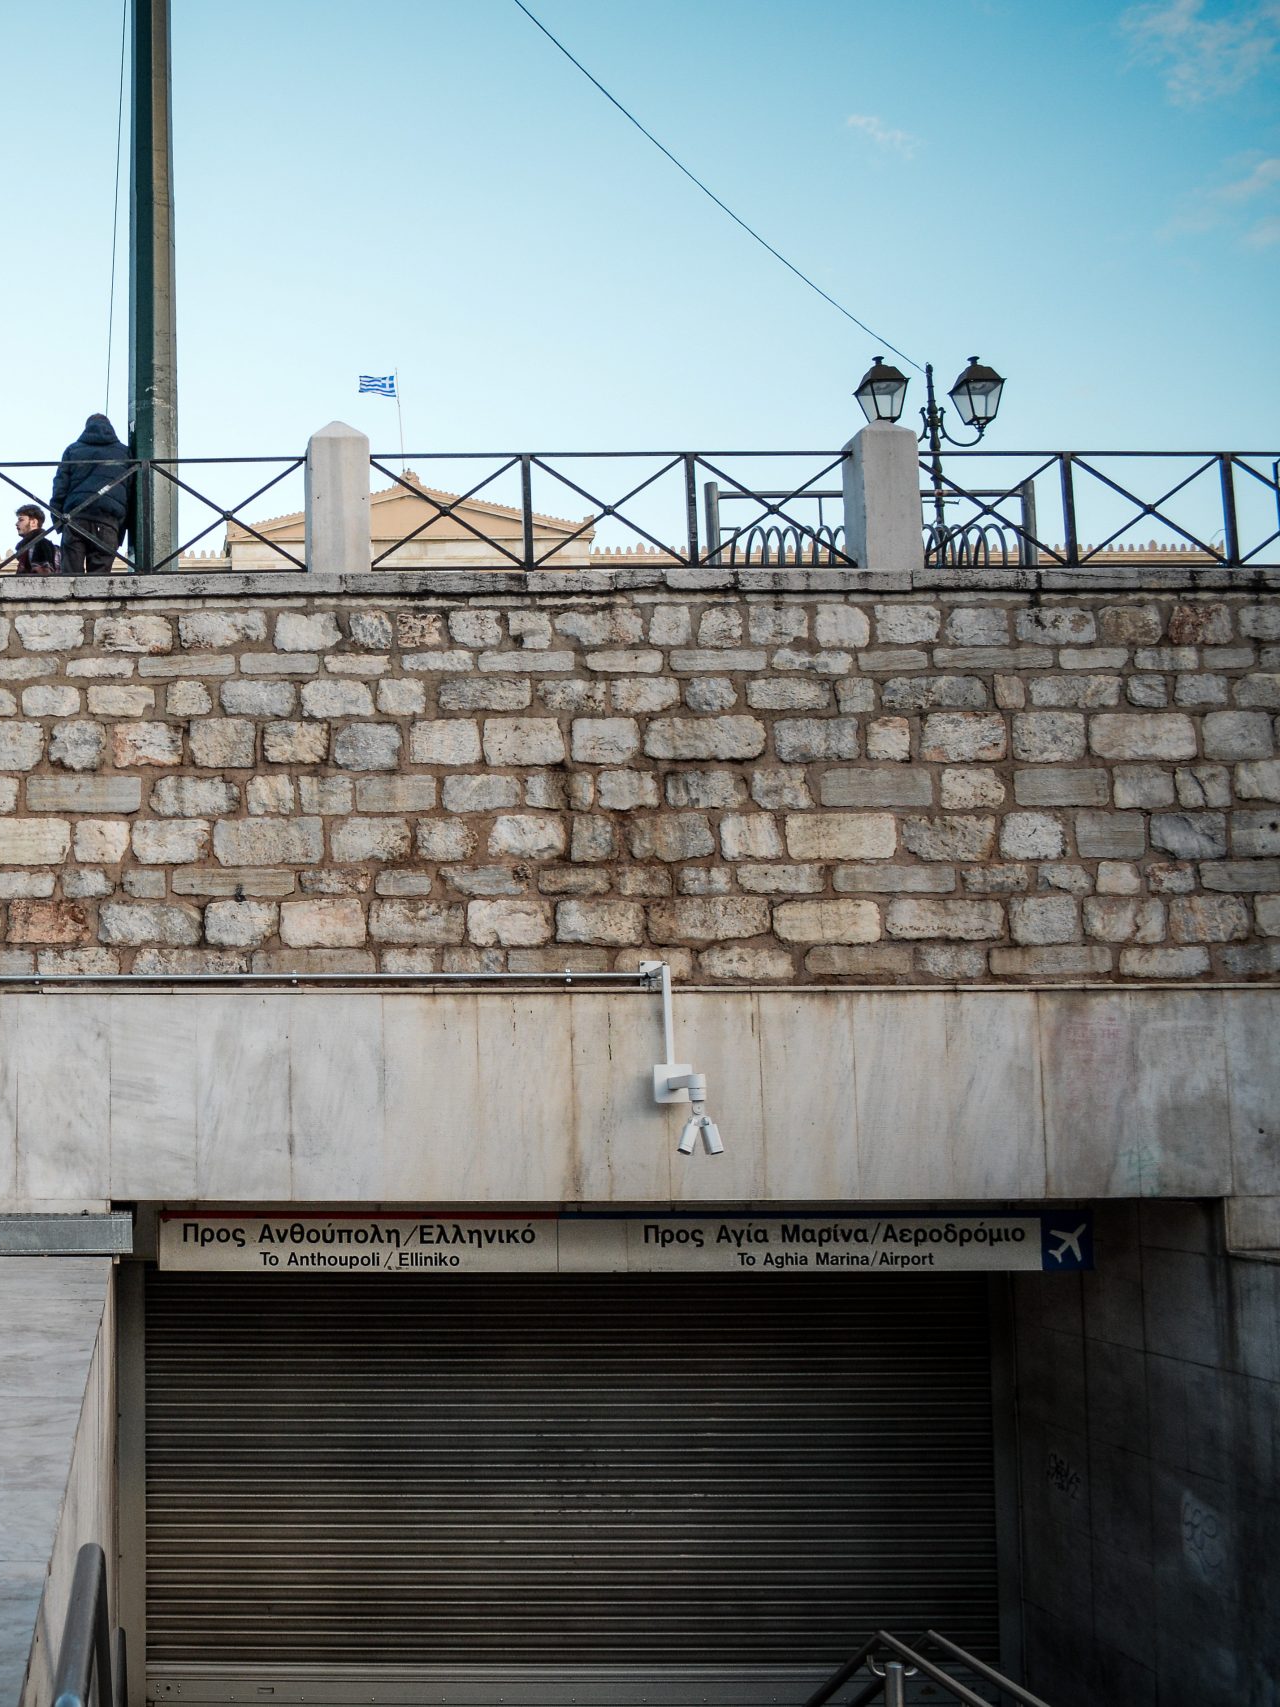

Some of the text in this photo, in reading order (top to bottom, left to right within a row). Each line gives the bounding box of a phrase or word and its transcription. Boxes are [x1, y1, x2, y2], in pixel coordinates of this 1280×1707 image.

[182, 1222, 536, 1249] Προς Ανθούπολη/Ελληνικό
[643, 1222, 1027, 1248] Προς Αγία Μαρίνα/Αεροδρόμιο
[259, 1252, 280, 1267] To
[737, 1251, 935, 1269] To Aghia Marina/Airport
